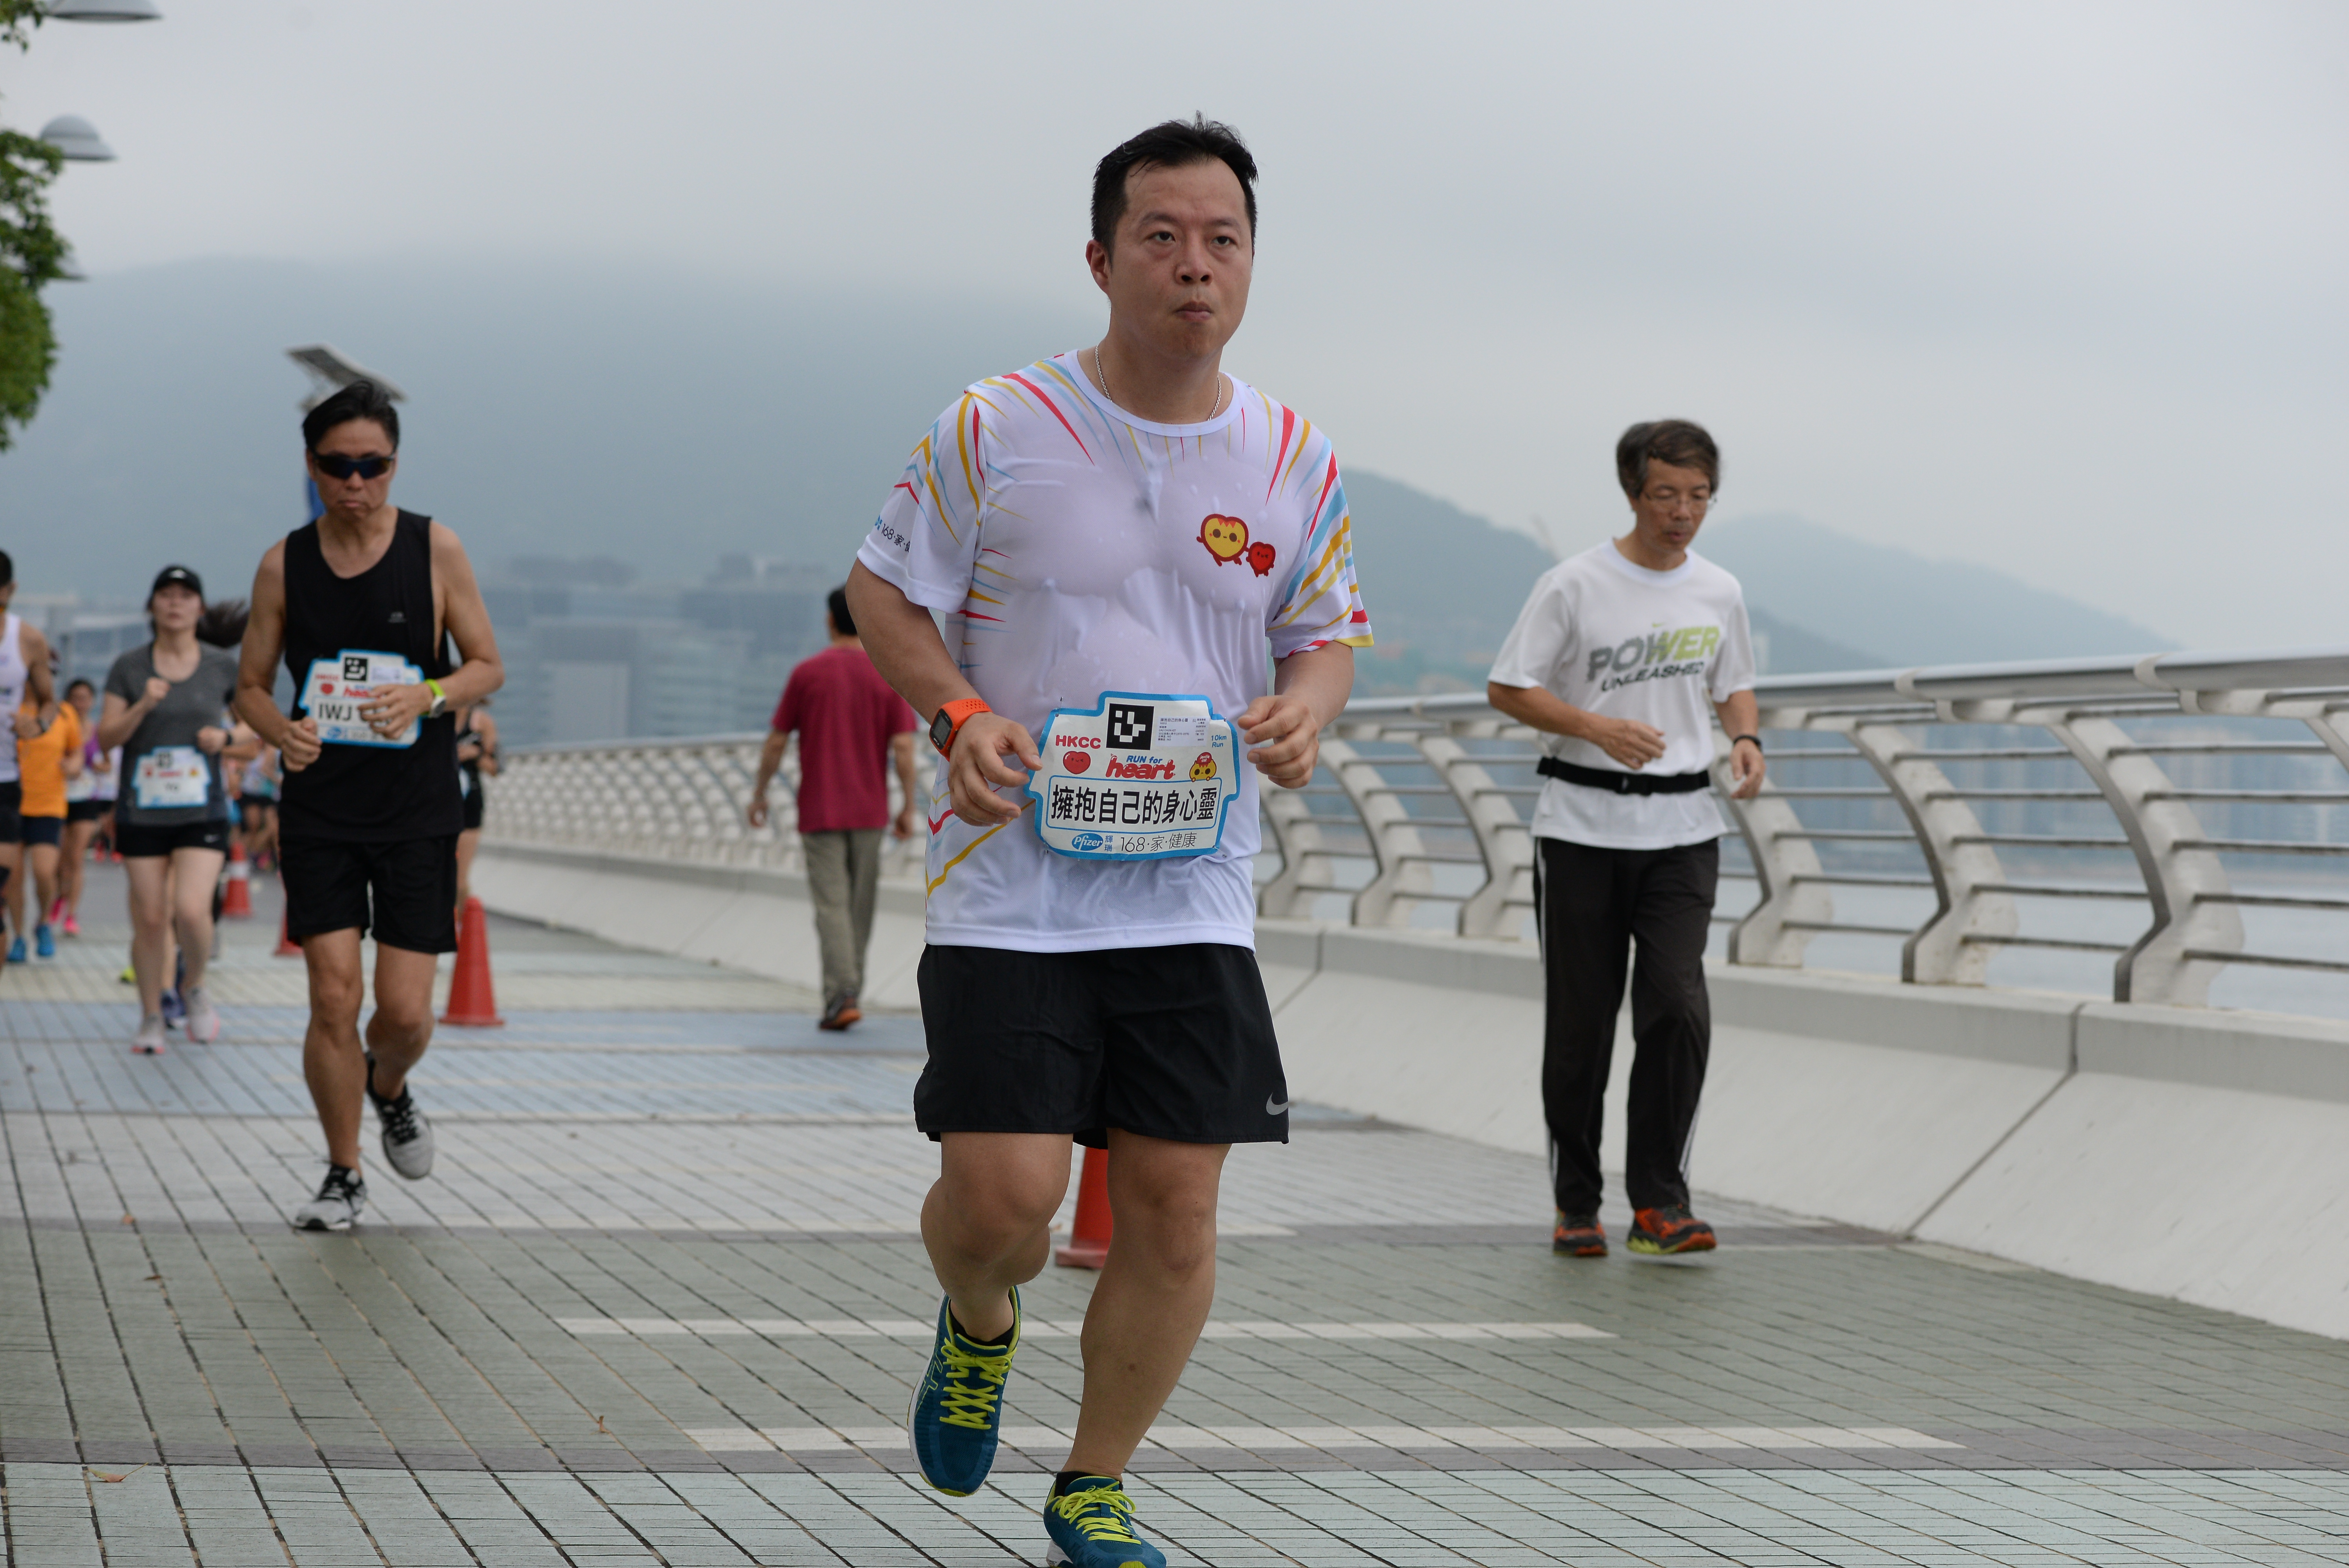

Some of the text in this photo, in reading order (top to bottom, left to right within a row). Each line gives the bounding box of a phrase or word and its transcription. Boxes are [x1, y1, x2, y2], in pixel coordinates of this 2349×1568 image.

[1586, 626, 1720, 683] POWER
[1602, 662, 1704, 692] UNLEASHED
[318, 703, 351, 721] IWJ
[1055, 735, 1101, 749] HKCC
[1105, 755, 1175, 780] heart
[1126, 755, 1147, 763] RUN
[1051, 784, 1217, 825] 擁抱自己的身心靈
[1074, 835, 1103, 851] Pfizer
[1105, 835, 1113, 852] 輝瑞
